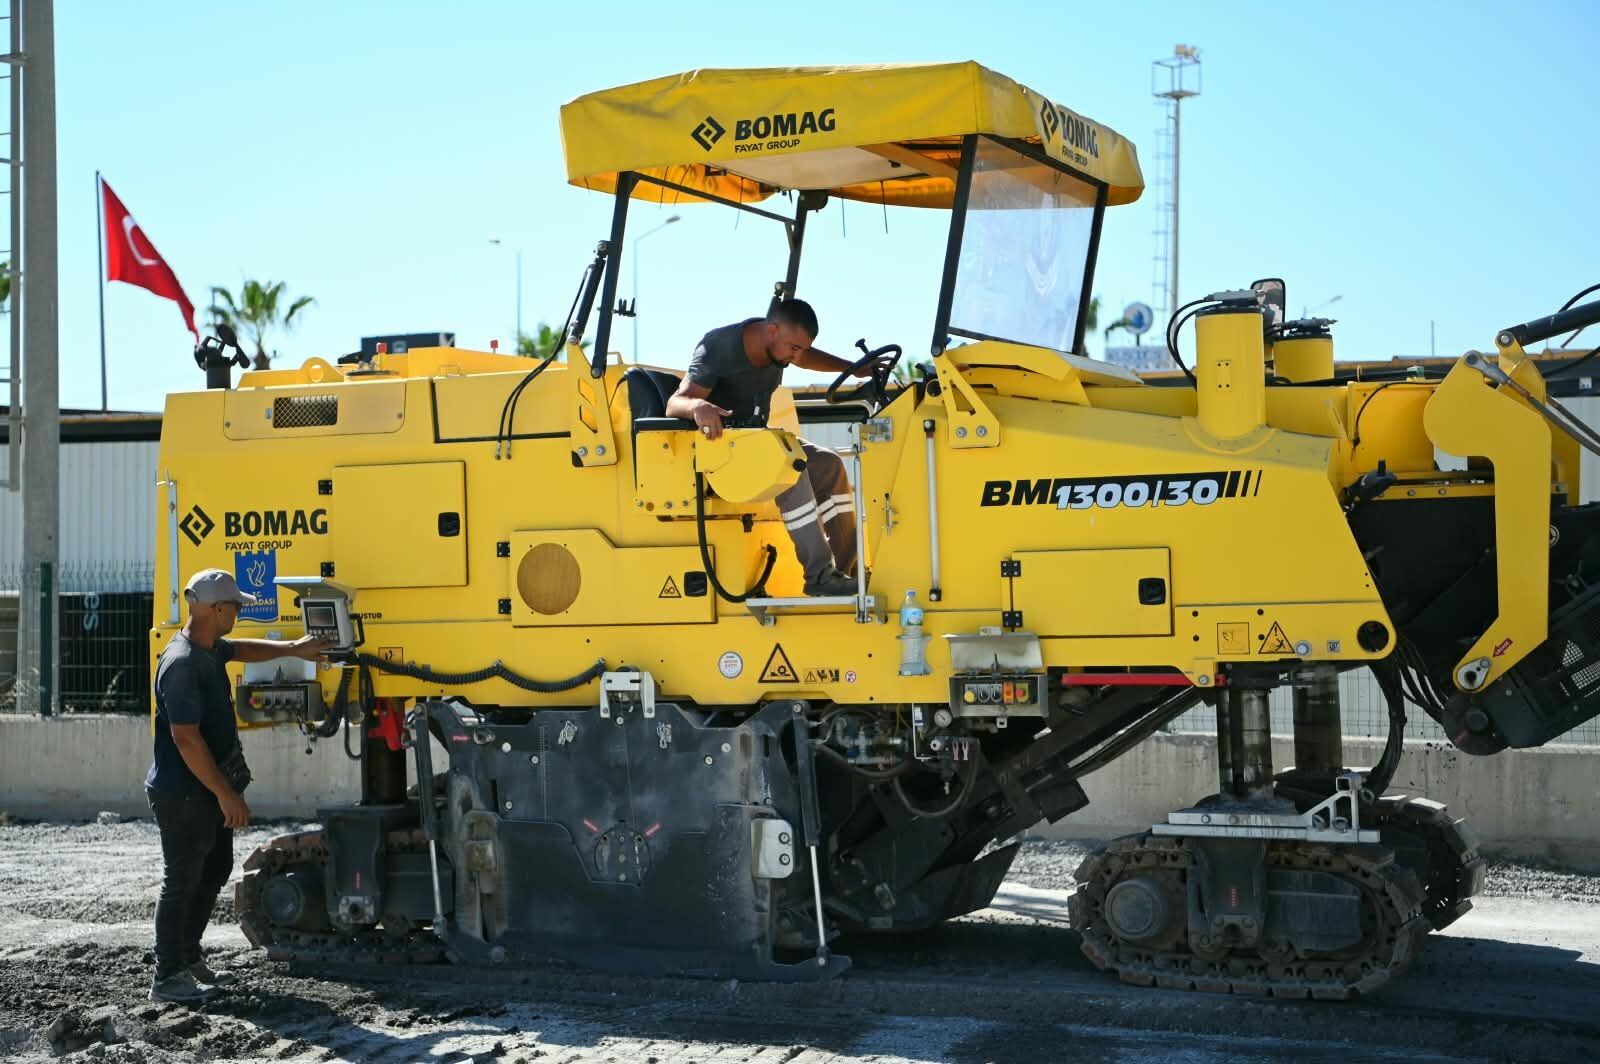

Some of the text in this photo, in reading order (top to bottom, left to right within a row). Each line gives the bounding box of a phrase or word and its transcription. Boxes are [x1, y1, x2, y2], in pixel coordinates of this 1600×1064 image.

[735, 108, 836, 141] BOMAG
[735, 139, 800, 153] FAYAT GROUP
[224, 508, 329, 537] BOMAG
[225, 540, 293, 551] FAYAT GROUP
